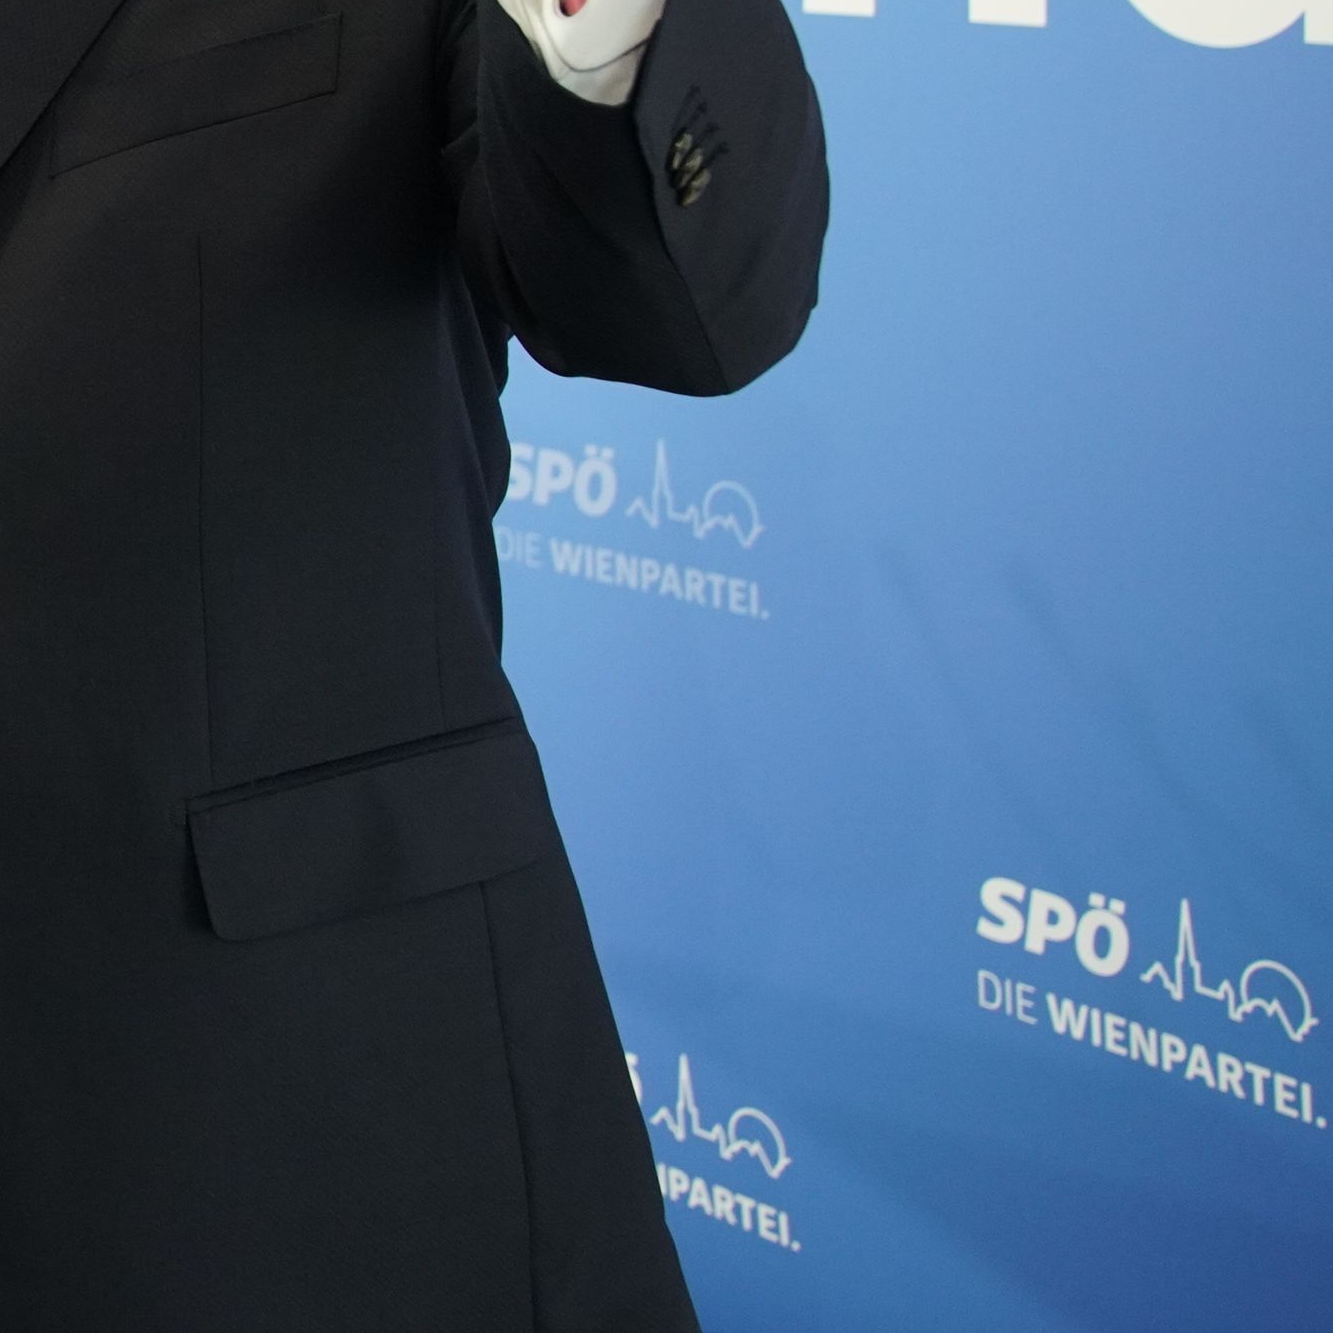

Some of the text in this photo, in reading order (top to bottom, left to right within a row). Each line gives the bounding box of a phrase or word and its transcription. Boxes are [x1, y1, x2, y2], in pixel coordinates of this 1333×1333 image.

[549, 537, 769, 620] WIENPARTEI.
[976, 877, 1130, 977] SPÖ
[976, 969, 1328, 1129] DIE WIENPARTEI.
